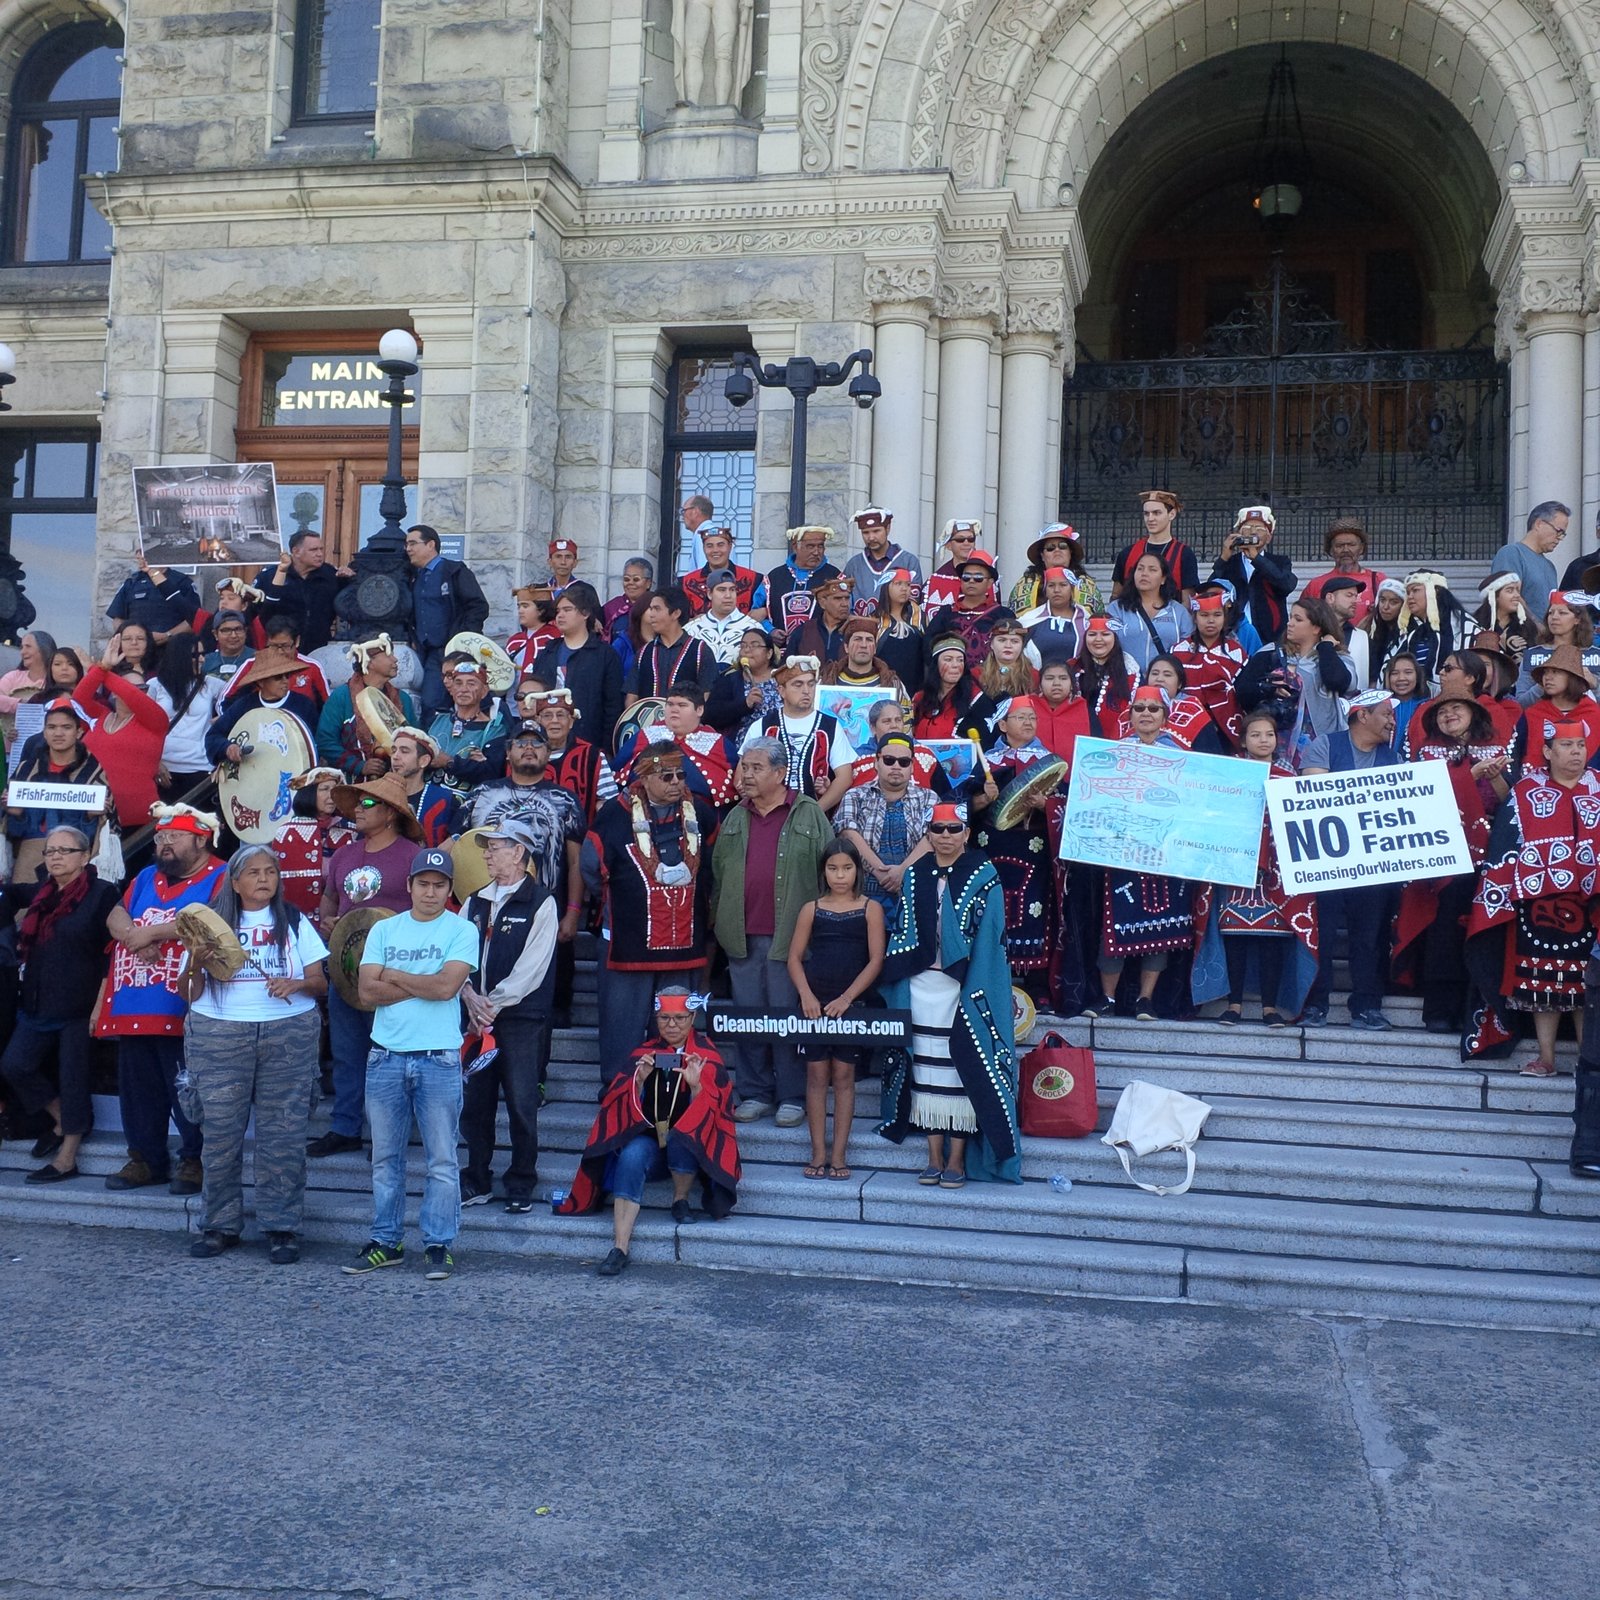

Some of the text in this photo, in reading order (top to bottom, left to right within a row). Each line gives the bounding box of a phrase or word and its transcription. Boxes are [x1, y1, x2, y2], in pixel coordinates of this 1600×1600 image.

[311, 361, 384, 381] MAIN
[148, 486, 170, 498] For
[173, 486, 195, 497] our
[1207, 783, 1243, 795] SALMON
[1295, 770, 1414, 794] Musgamagw
[16, 787, 97, 803] #FishFarmsGetOut
[1285, 807, 1416, 863] NO Fish
[1362, 829, 1450, 854] Farms
[1294, 854, 1457, 884] CleansingOurWaters.com
[713, 1014, 905, 1038] CleansingOurWaters.com
[1036, 1067, 1070, 1082] COUNTRY
[1037, 1086, 1069, 1098] GROCER
